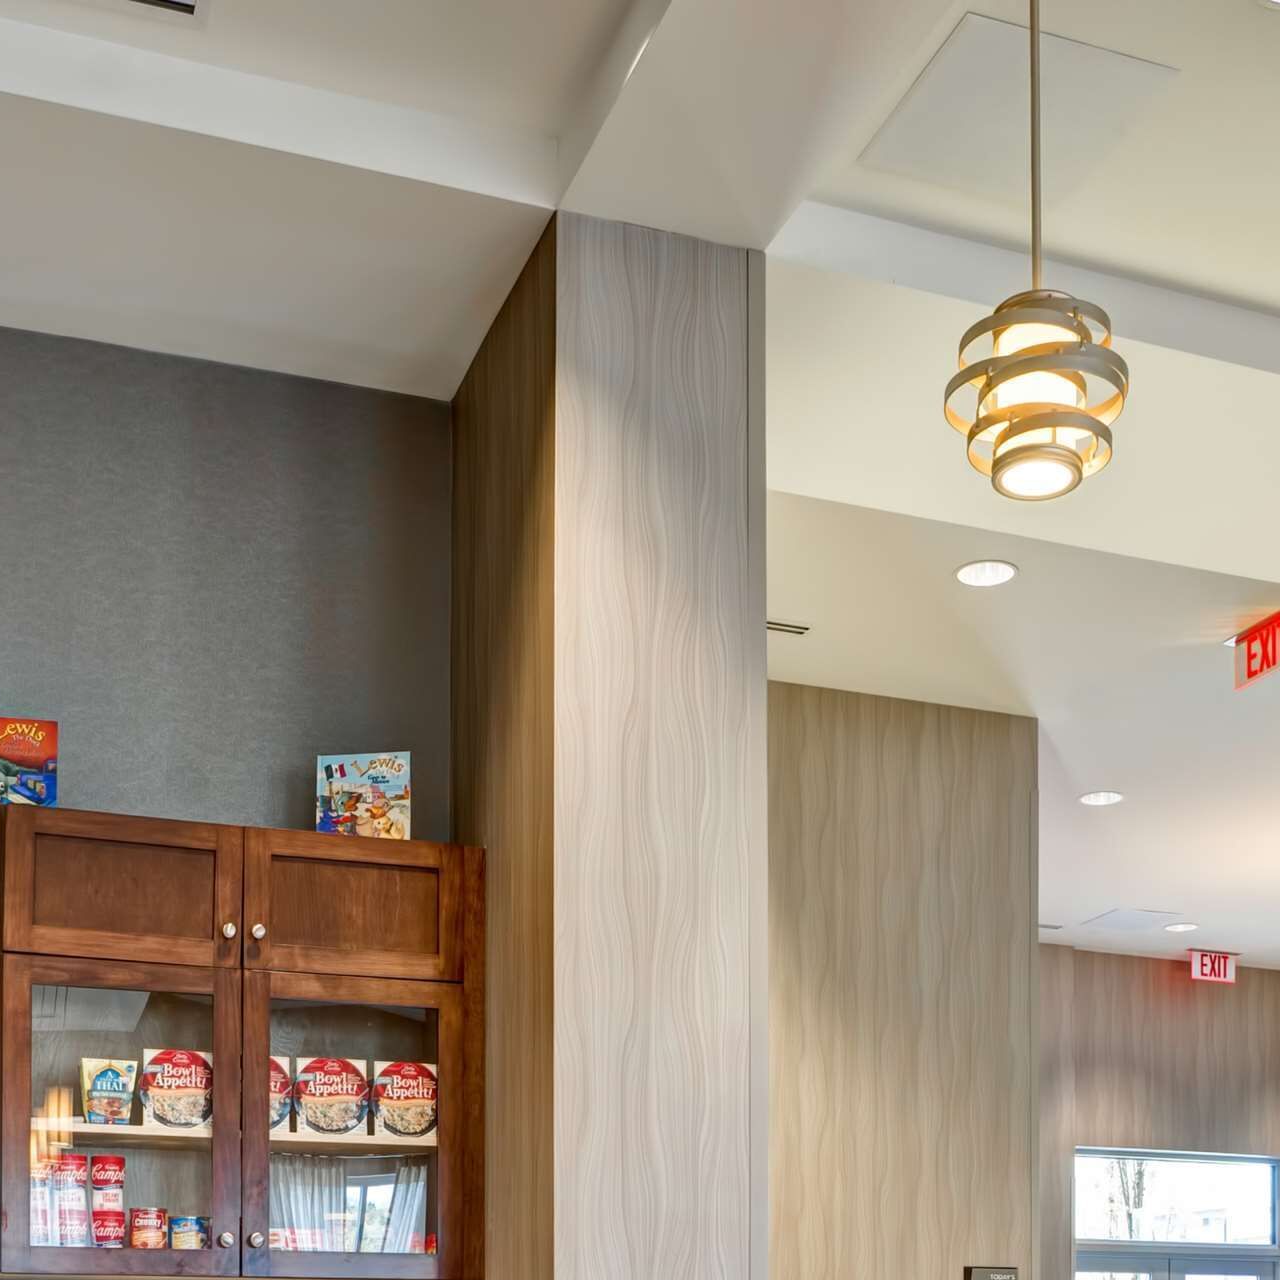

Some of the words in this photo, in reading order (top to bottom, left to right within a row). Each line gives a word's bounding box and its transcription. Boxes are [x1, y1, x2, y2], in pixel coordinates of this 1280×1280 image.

[350, 755, 405, 778] Lewis
[1200, 953, 1230, 979] EXIT
[163, 1063, 196, 1077] Bowl
[96, 1081, 123, 1090] THAI
[315, 1072, 348, 1085] Bowl
[392, 1075, 423, 1089] Bowl
[990, 1273, 1017, 1280] TODAY'S
